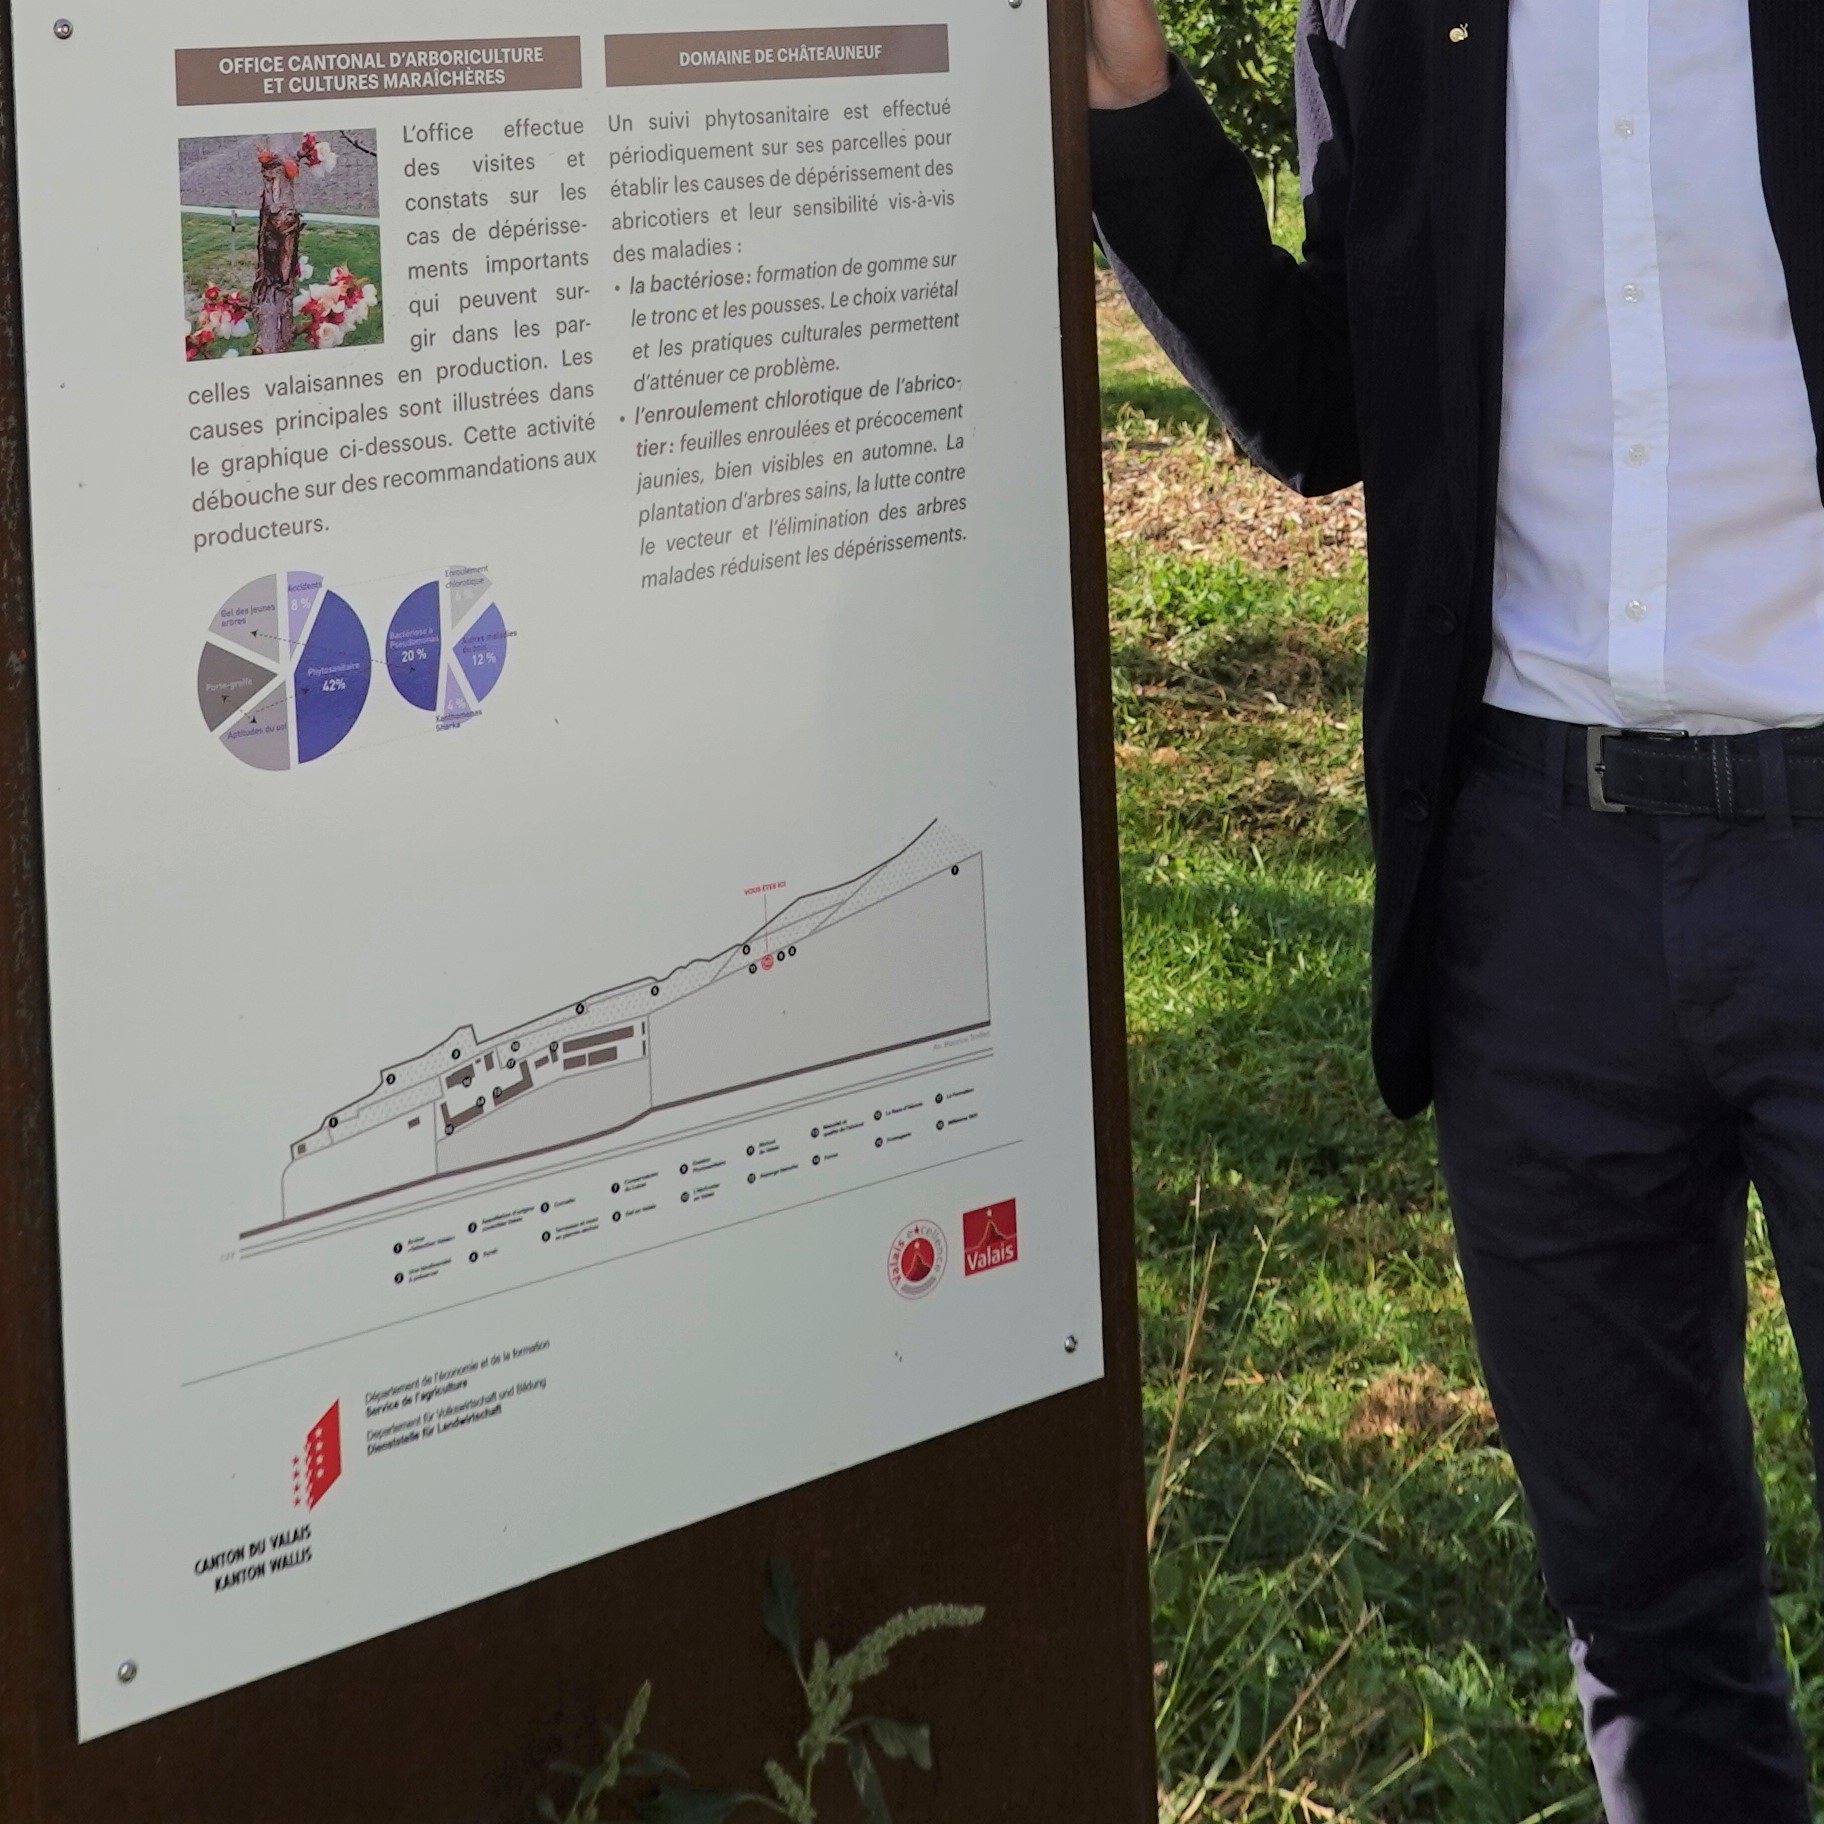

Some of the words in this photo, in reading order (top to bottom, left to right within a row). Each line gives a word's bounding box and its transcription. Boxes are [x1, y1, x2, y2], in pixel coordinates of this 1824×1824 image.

[218, 55, 285, 75] OFFICE
[287, 52, 386, 72] CANTONAL
[389, 46, 544, 68] D'ARBORICULTURE
[679, 49, 754, 67] DOMAINE
[754, 48, 775, 64] DE
[776, 43, 883, 63] CHÂTEAUNEUF
[263, 77, 285, 95] ET
[288, 73, 380, 94] CULTURES
[383, 65, 506, 94] MARAÎCHÈRES
[402, 121, 474, 144] L'office
[503, 117, 584, 138] effectue
[608, 114, 633, 133] Un
[648, 110, 690, 131] suivi
[705, 104, 830, 132] phytosanitaire
[843, 103, 869, 120] est
[882, 96, 952, 118] effectué
[609, 141, 755, 170] périodiquement
[761, 141, 789, 156] sur
[795, 139, 824, 155] ses
[831, 128, 908, 156] parcelles
[914, 132, 952, 151] pour
[406, 229, 440, 246] cas
[451, 222, 477, 243] de
[488, 216, 588, 242] dépérisse-
[407, 259, 469, 280] ments
[485, 250, 590, 276] importants
[632, 342, 651, 360] et
[658, 337, 683, 358] les
[691, 332, 773, 359] pratiques
[780, 320, 862, 345] culturales
[869, 312, 960, 340] permettent
[187, 381, 250, 406] celles
[264, 371, 384, 398] valaisannes
[397, 367, 422, 384] en
[436, 352, 548, 385] production.
[561, 349, 594, 367] Les
[189, 418, 264, 441] causes
[275, 402, 389, 441] principales
[399, 397, 442, 418] sont
[452, 386, 540, 413] illustrées
[549, 381, 595, 402] dans
[634, 395, 760, 426] l'enroulement
[764, 384, 863, 410] chlorotique
[868, 378, 890, 398] de
[895, 373, 962, 395] l'abrico-
[191, 455, 210, 477] le
[220, 446, 329, 478] graphique
[339, 433, 453, 460] ci-dessous.
[463, 424, 517, 445] Cette
[526, 411, 596, 438] activité
[641, 562, 716, 589] malades
[720, 549, 802, 577] réduisent
[805, 544, 830, 564] les
[833, 527, 967, 561] dépérissements.
[322, 676, 345, 693] 42%
[966, 1242, 1014, 1271] Valais
[365, 1398, 399, 1418] Service
[401, 1394, 412, 1407] de
[194, 1545, 244, 1576] CANTON
[248, 1538, 266, 1558] DU
[269, 1523, 311, 1551] VALAIS
[214, 1561, 264, 1593] KANTON
[269, 1545, 312, 1574] WALLIS
